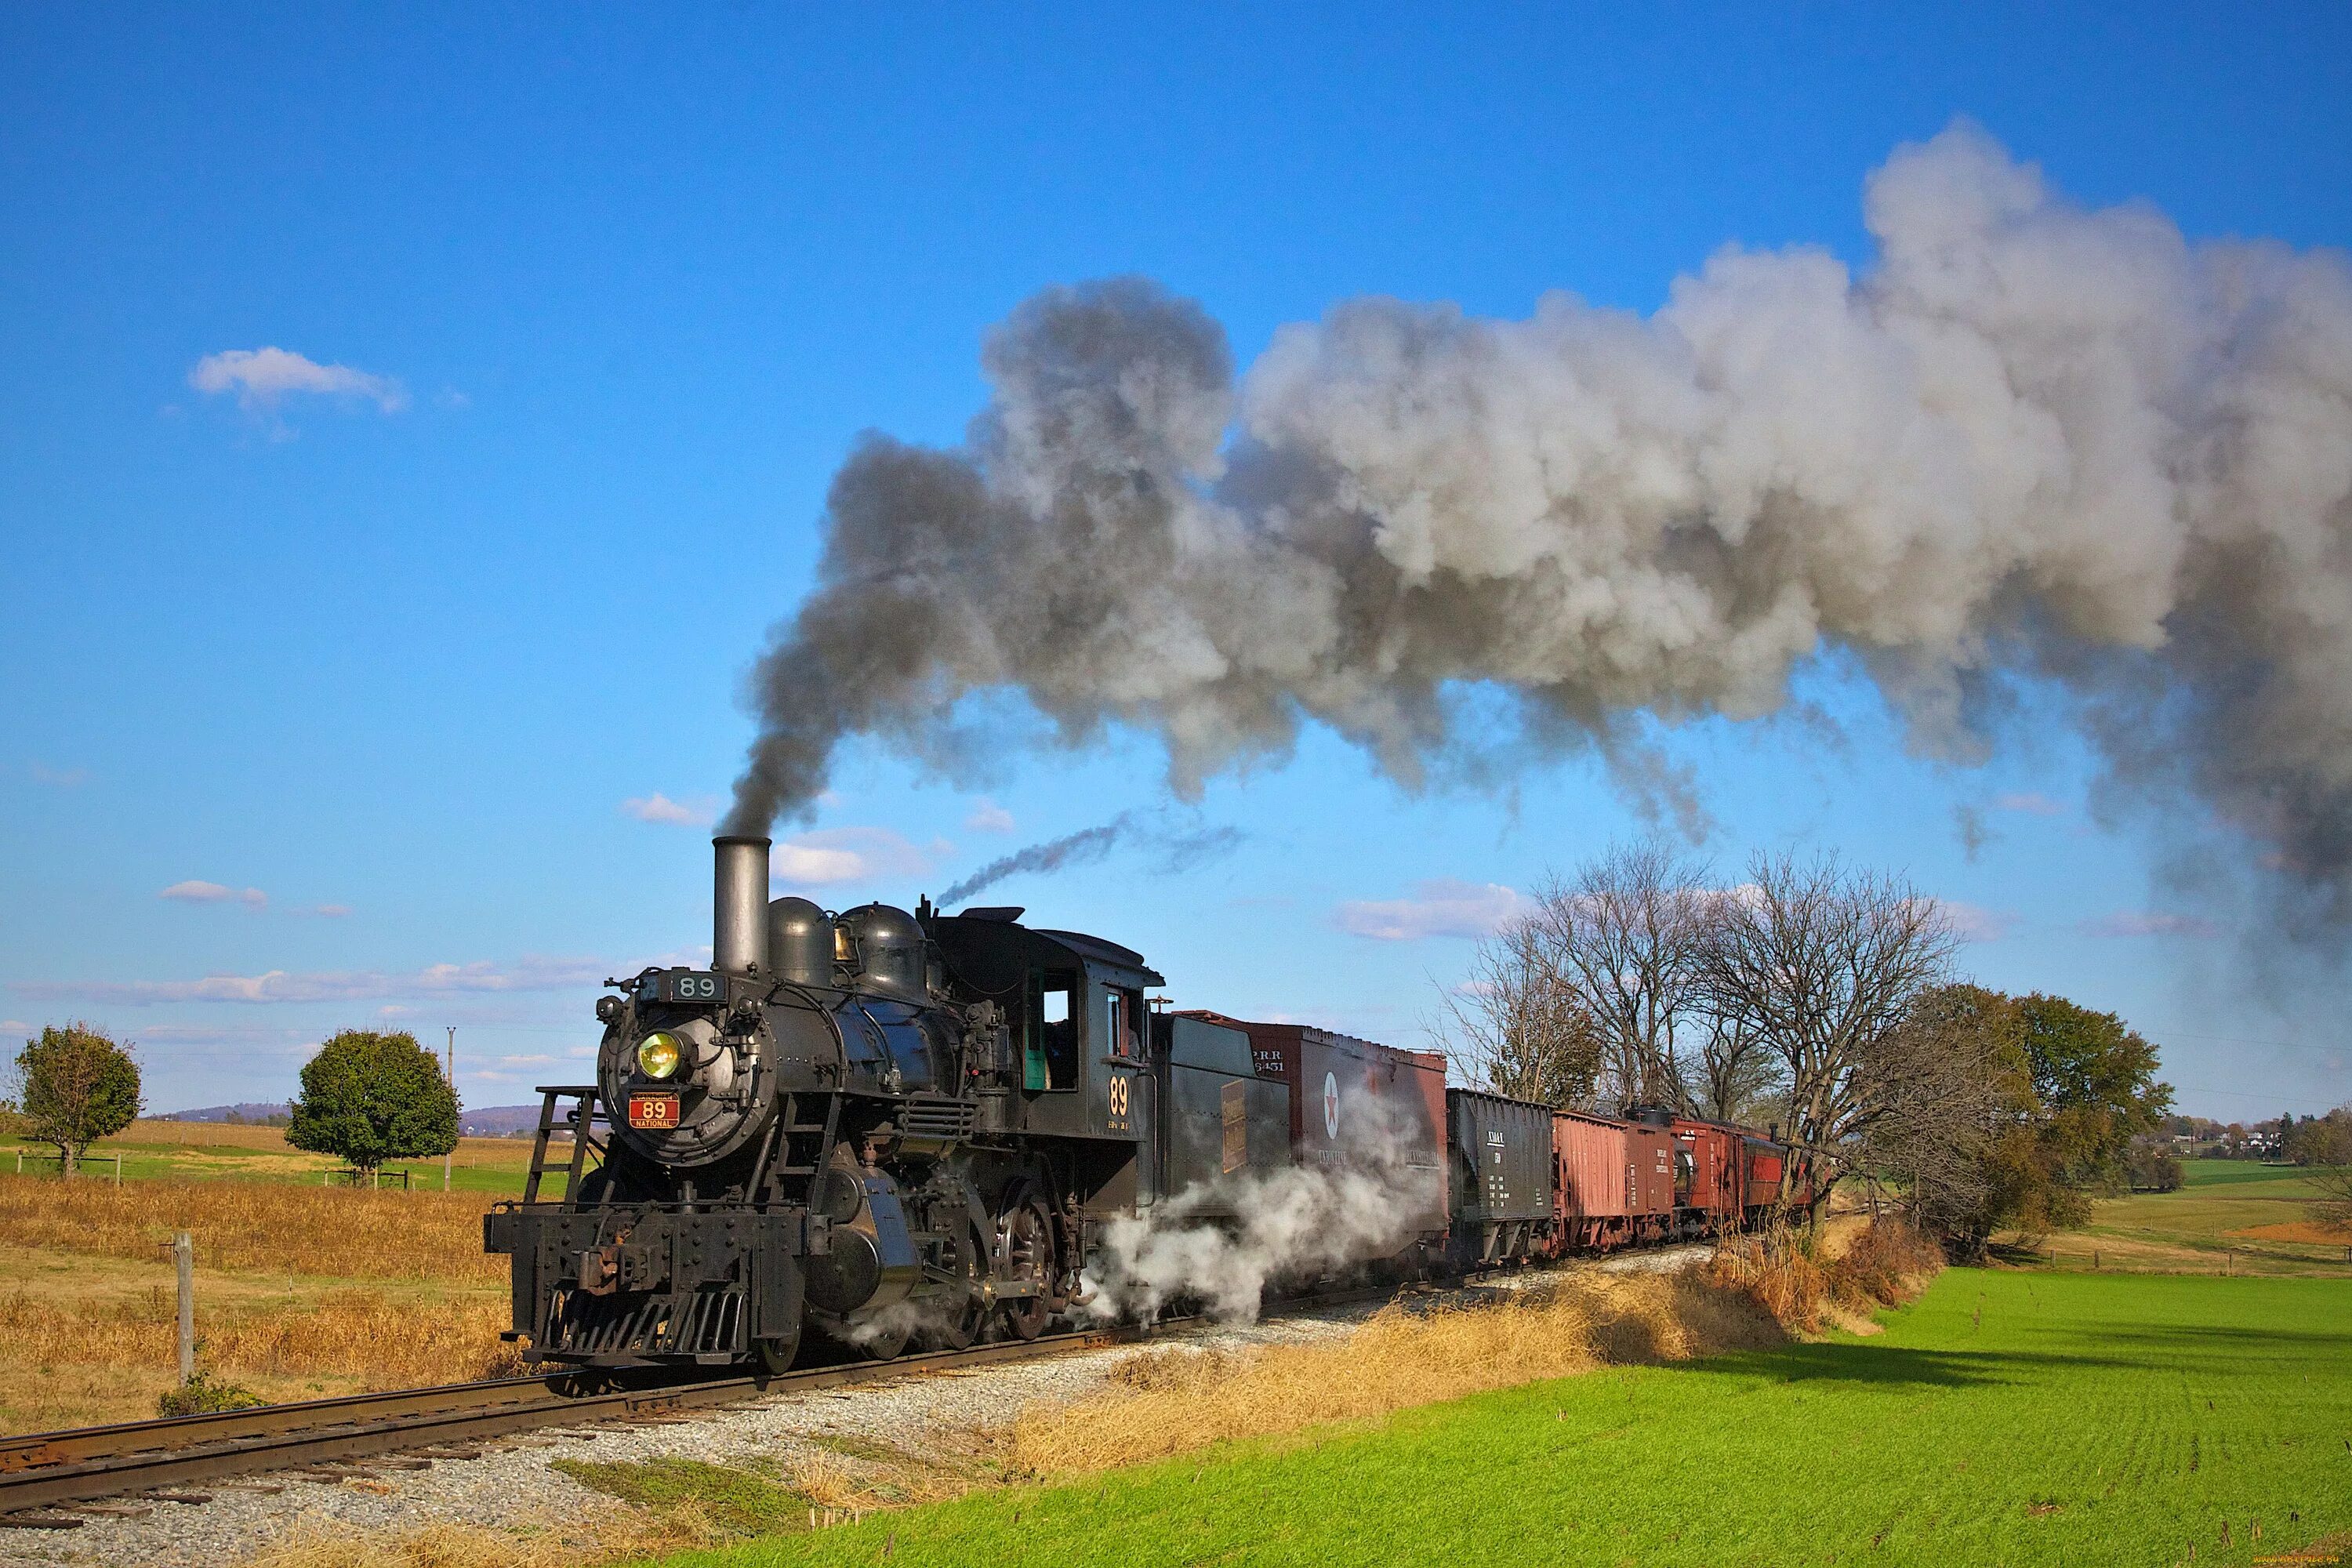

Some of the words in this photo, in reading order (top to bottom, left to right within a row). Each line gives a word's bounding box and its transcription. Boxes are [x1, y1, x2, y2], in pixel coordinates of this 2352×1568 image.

[680, 977, 714, 997] 89
[1109, 1076, 1127, 1116] 89
[643, 1102, 666, 1119] 89
